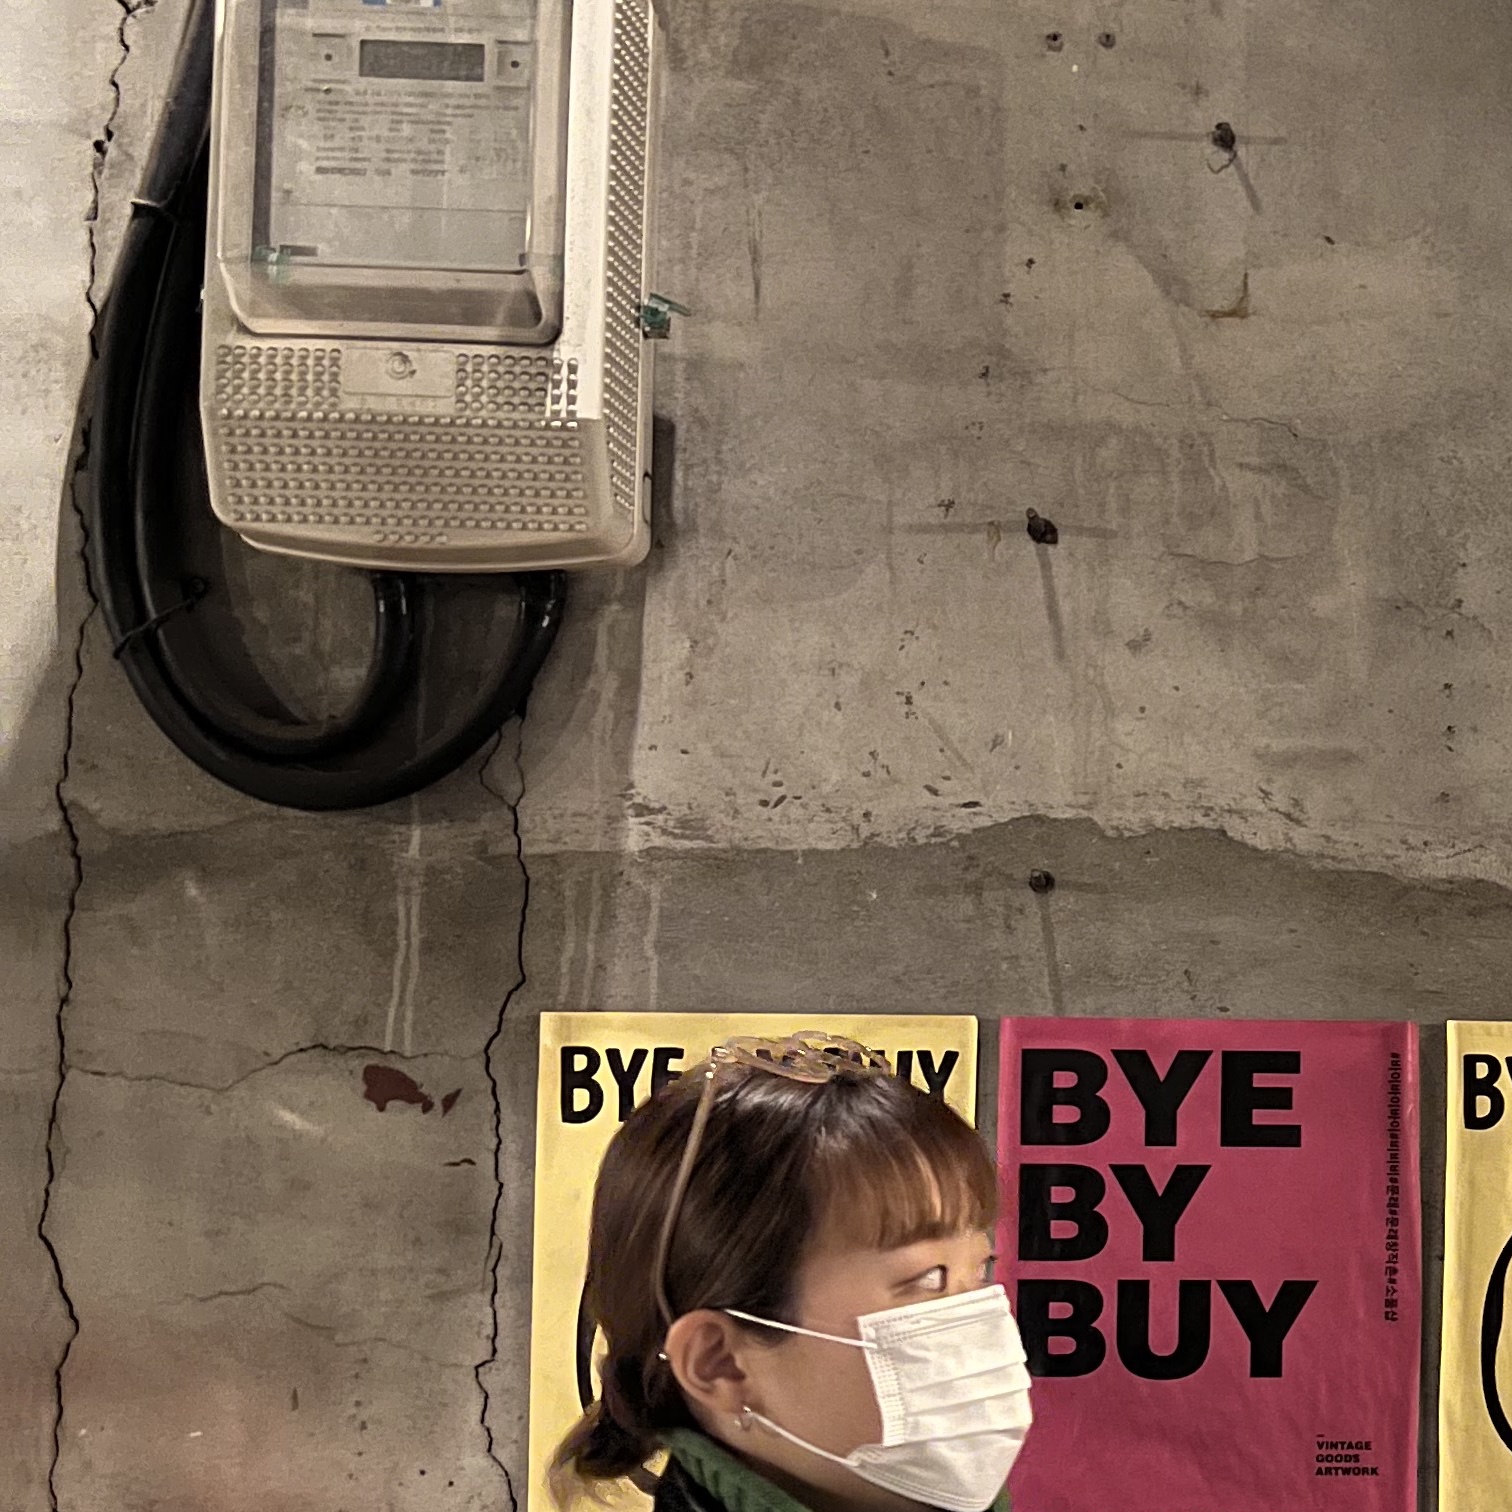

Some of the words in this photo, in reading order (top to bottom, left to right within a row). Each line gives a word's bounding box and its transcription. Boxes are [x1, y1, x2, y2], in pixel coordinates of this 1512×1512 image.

[1019, 1047, 1302, 1149] BYE
[1018, 1163, 1213, 1262] BY
[1017, 1279, 1319, 1381] BUY
[1315, 1453, 1361, 1463] GOODS
[1315, 1466, 1379, 1476] ARTWORK
[1316, 1441, 1372, 1451] VINTAGE
